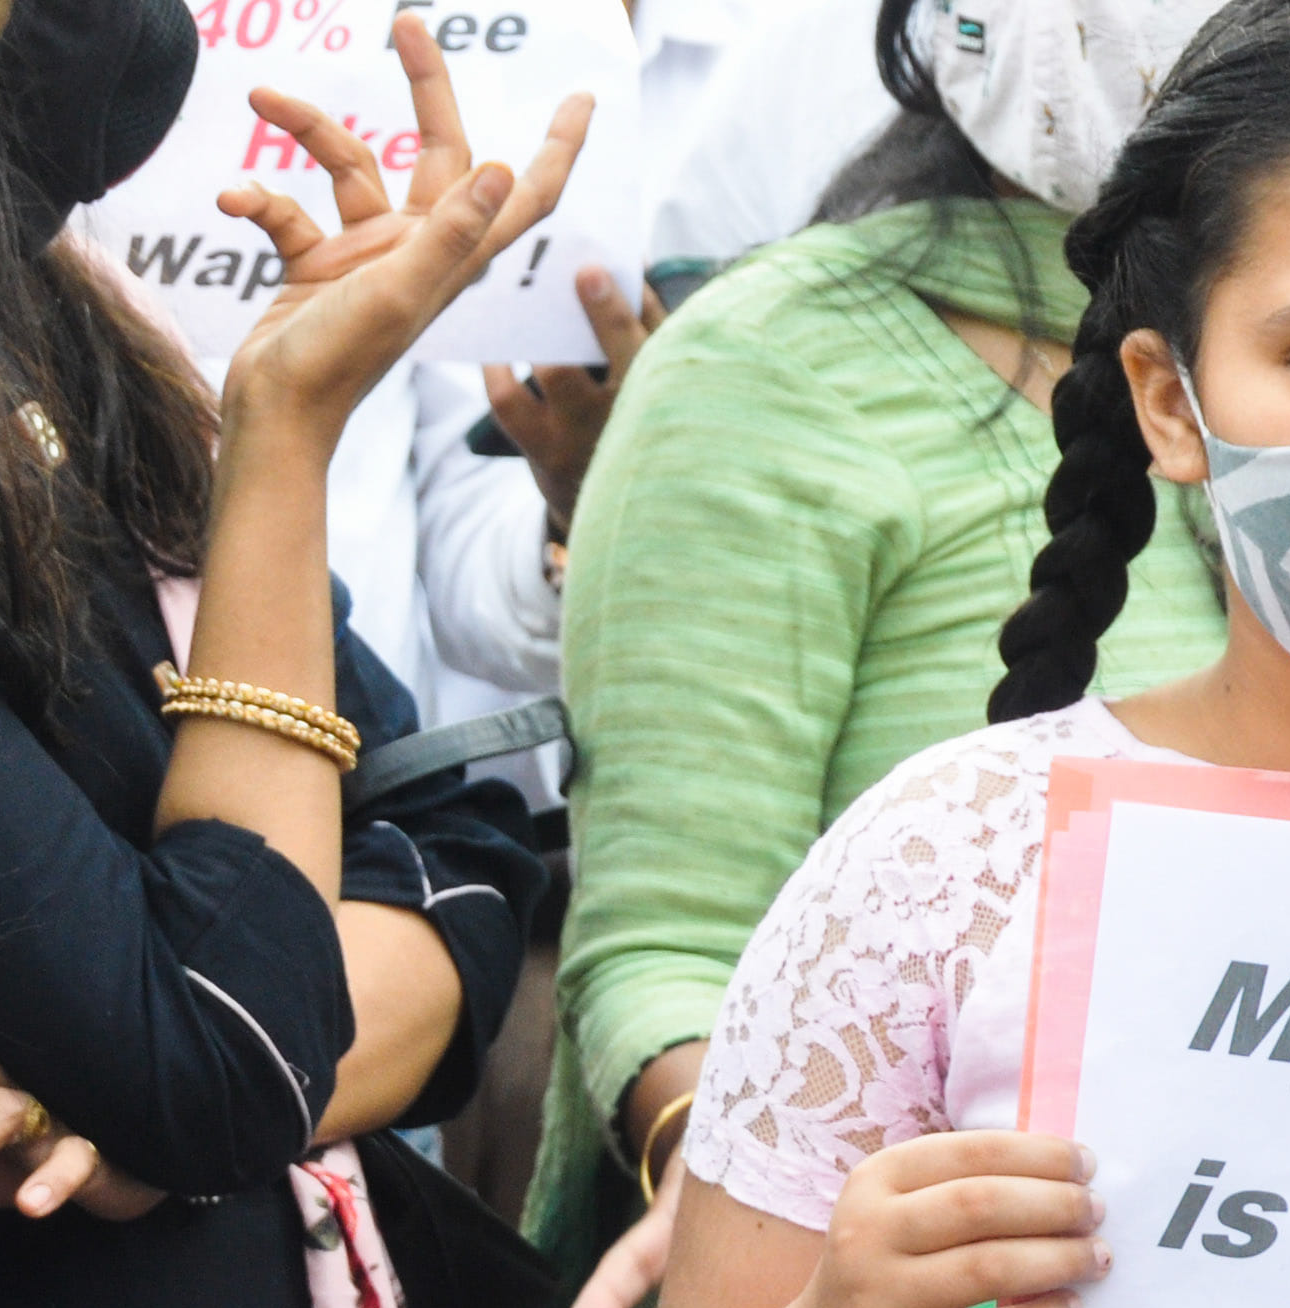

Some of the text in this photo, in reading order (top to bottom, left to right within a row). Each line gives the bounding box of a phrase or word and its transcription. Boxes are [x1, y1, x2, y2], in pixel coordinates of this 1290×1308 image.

[196, 0, 351, 52] 40%
[240, 115, 423, 171] He
[126, 235, 287, 301] Wap
[518, 237, 550, 288] !
[1157, 1158, 1288, 1260] is
